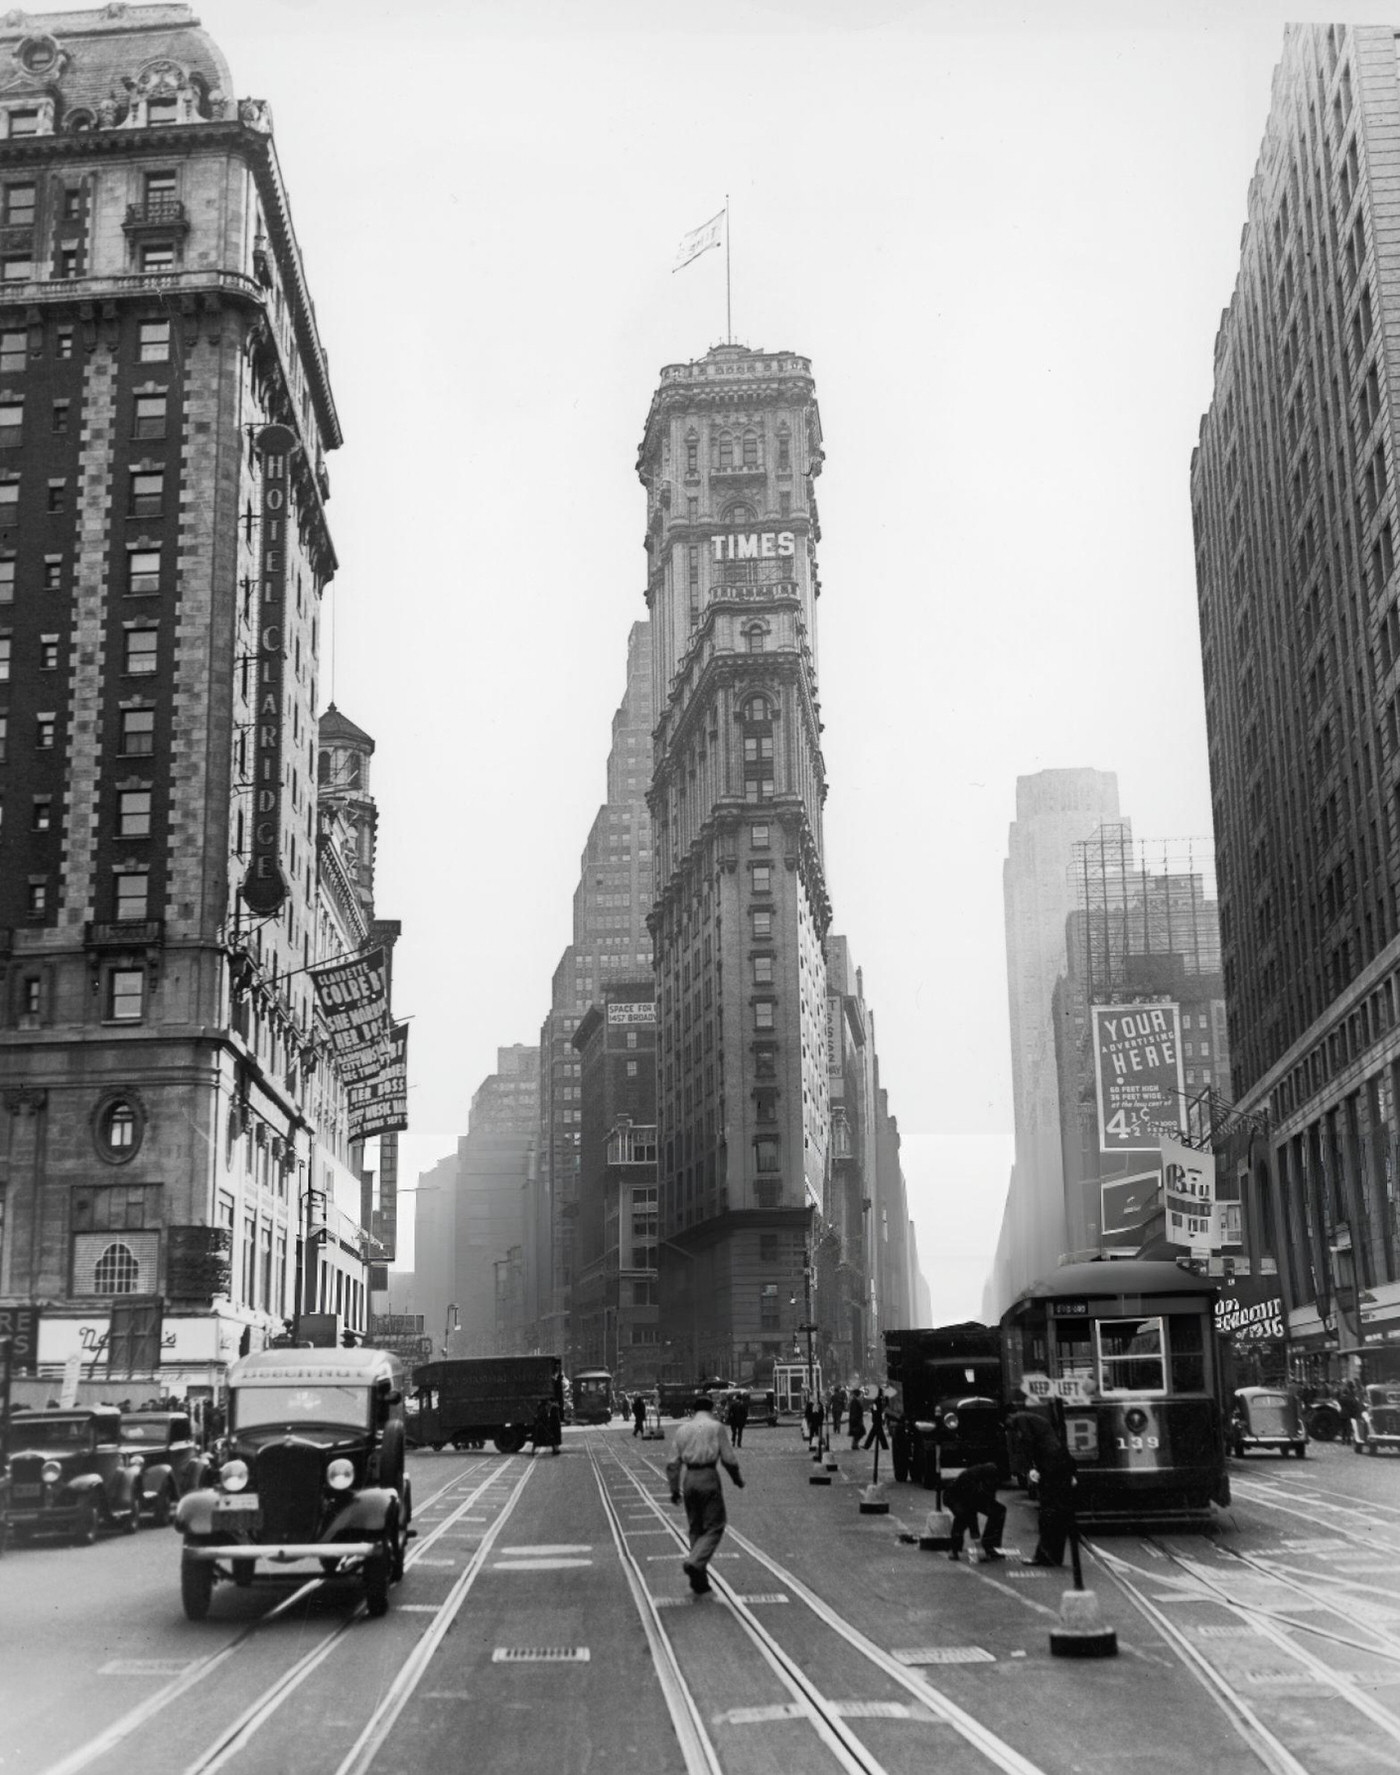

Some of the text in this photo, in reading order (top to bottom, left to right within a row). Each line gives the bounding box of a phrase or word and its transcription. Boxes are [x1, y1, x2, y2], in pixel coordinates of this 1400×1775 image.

[711, 531, 795, 560] TIMES
[257, 454, 284, 880] HOTEL CLARIDGE
[609, 1004, 634, 1013] SPACE
[638, 1004, 652, 1012] FOR
[609, 1013, 657, 1022] 1457 BROAD
[326, 1012, 351, 1032] SHE
[1104, 1010, 1167, 1041] YOUR
[334, 1029, 360, 1050] HER
[1102, 1030, 1175, 1053] ADVERTISING
[1112, 1042, 1175, 1075] HERE
[350, 1087, 372, 1104] HER
[377, 1078, 404, 1096] BOSS
[1122, 1085, 1140, 1093] FEET
[1141, 1084, 1160, 1092] HIGH
[365, 1101, 392, 1120] MUSIC
[1029, 1380, 1079, 1396] KEEP LEFT
[1116, 1436, 1160, 1450] 139
